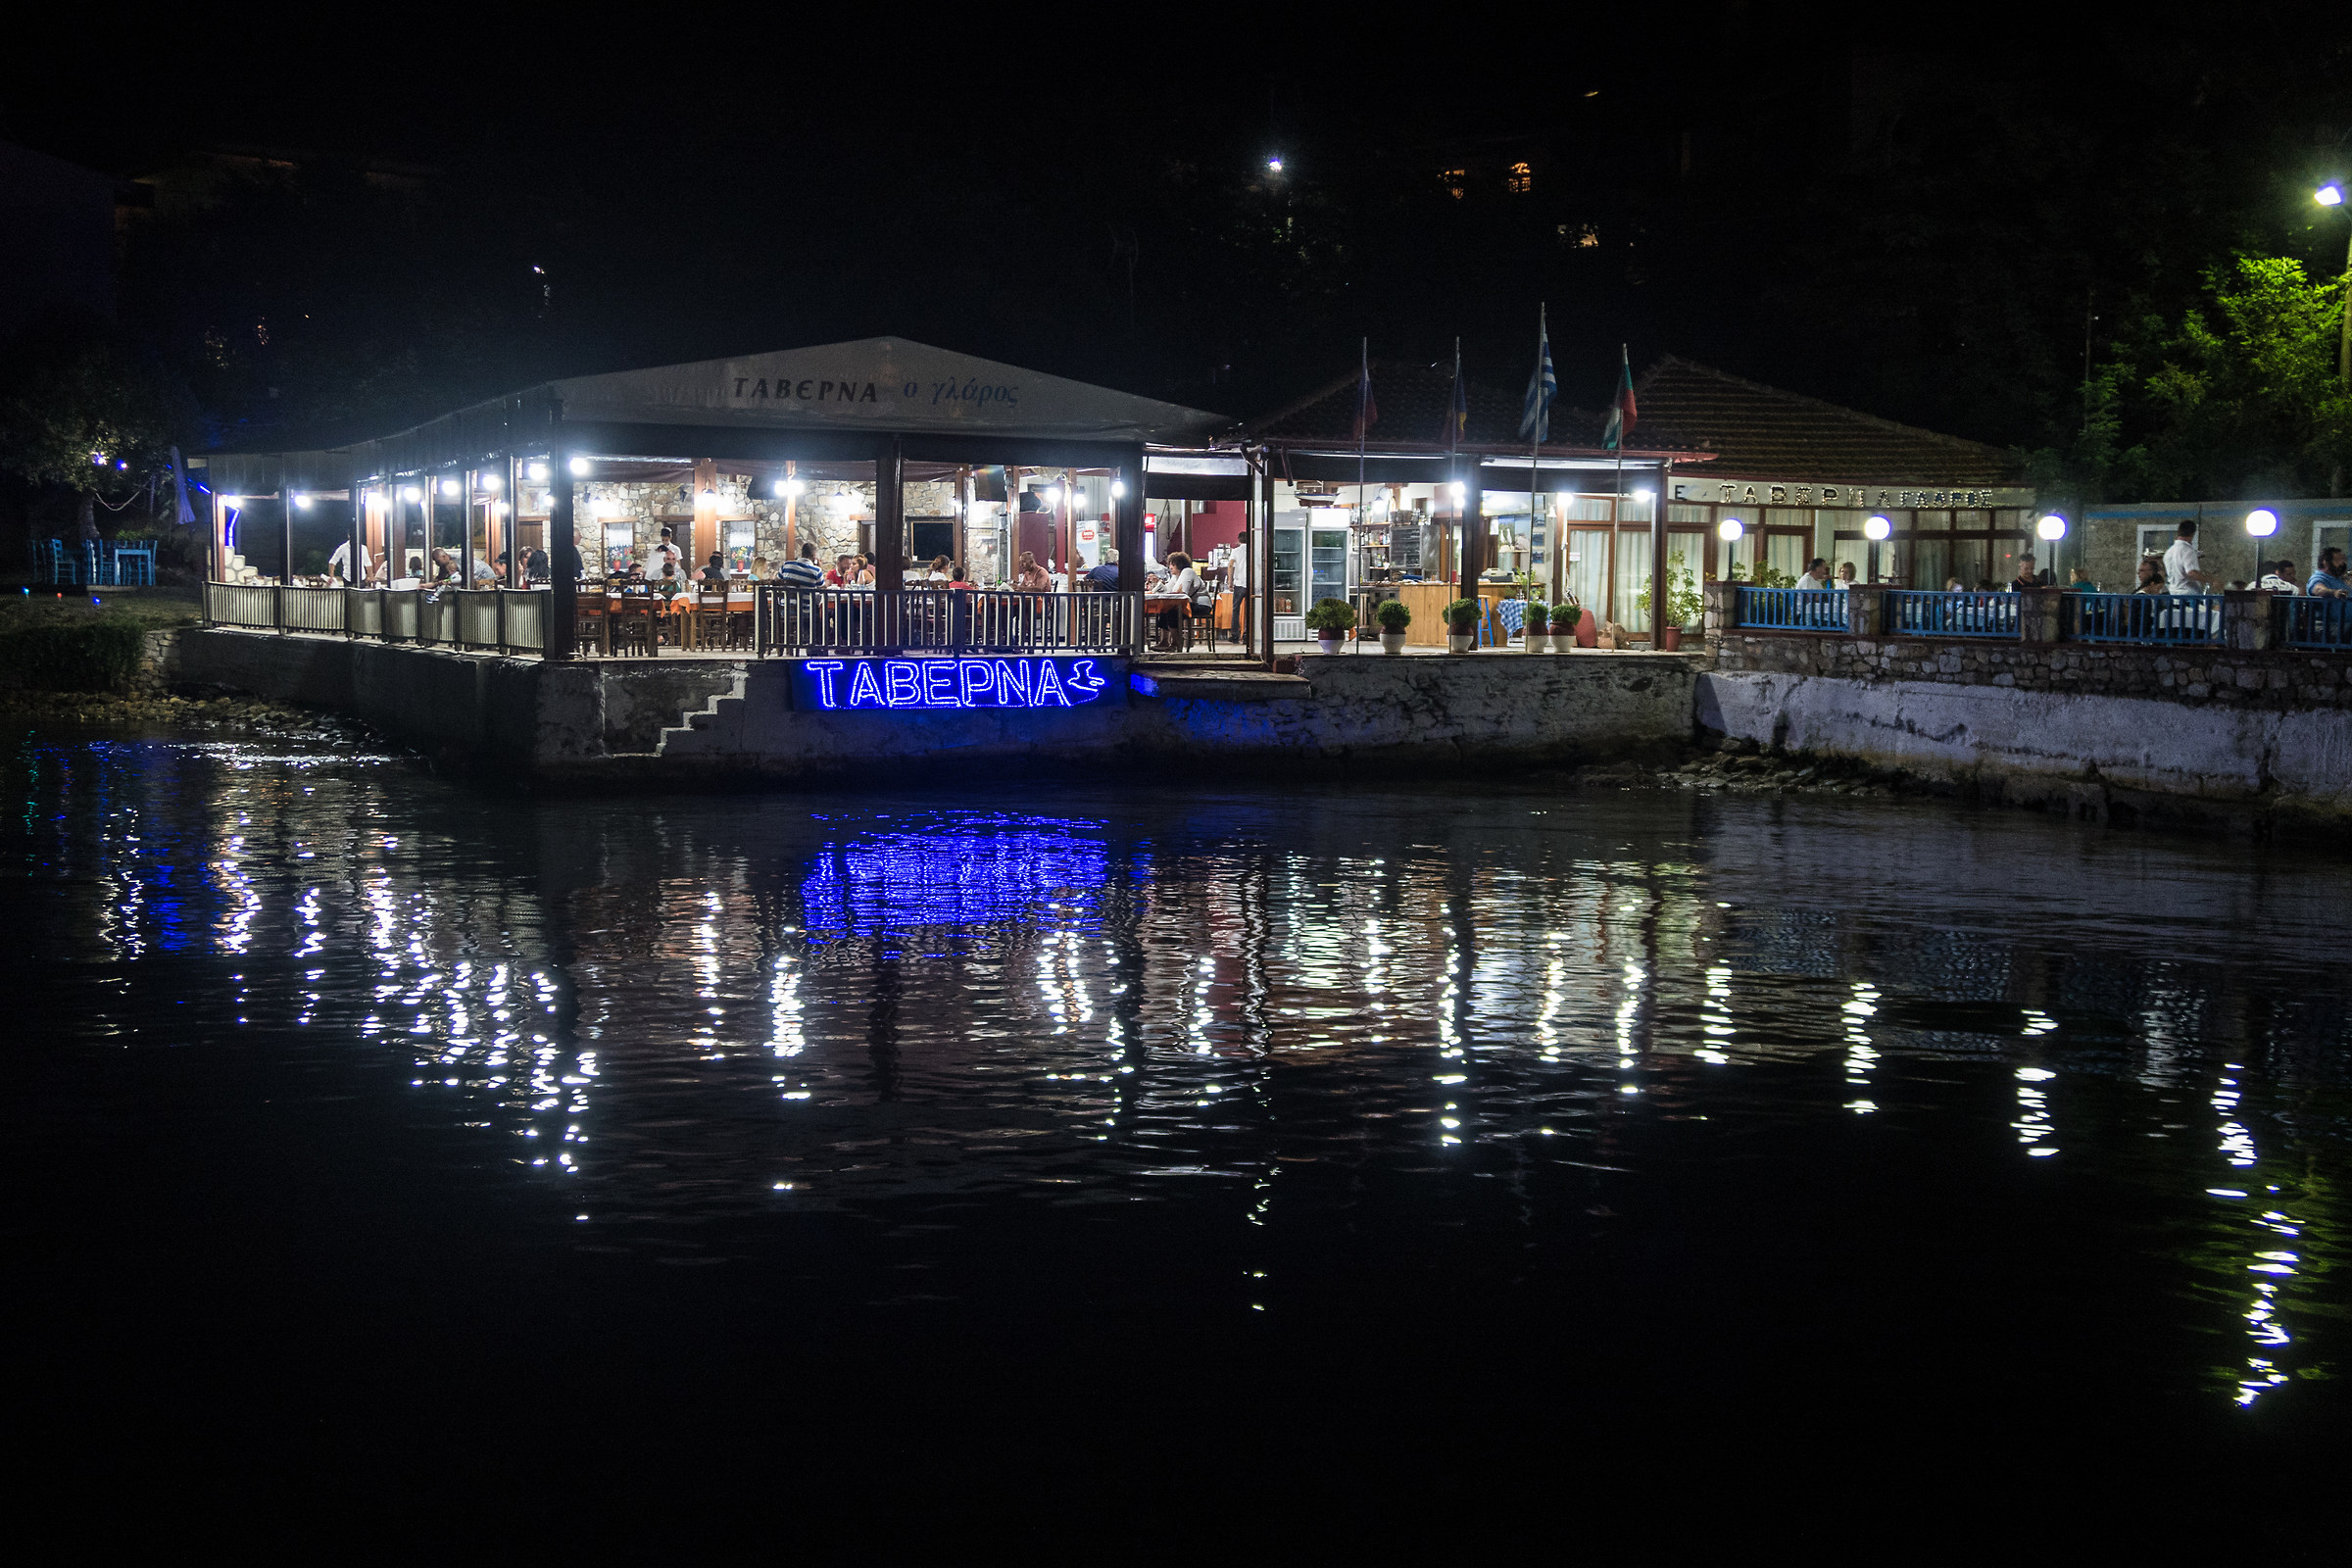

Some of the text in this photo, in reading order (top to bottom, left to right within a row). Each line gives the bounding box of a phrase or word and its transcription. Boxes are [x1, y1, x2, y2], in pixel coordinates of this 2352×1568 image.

[931, 376, 1018, 409] γλάρος
[1719, 483, 1891, 509] ΤΑΒΕΡΝΑ
[807, 660, 1071, 708] ΤΑΒΕΡΝΑ
